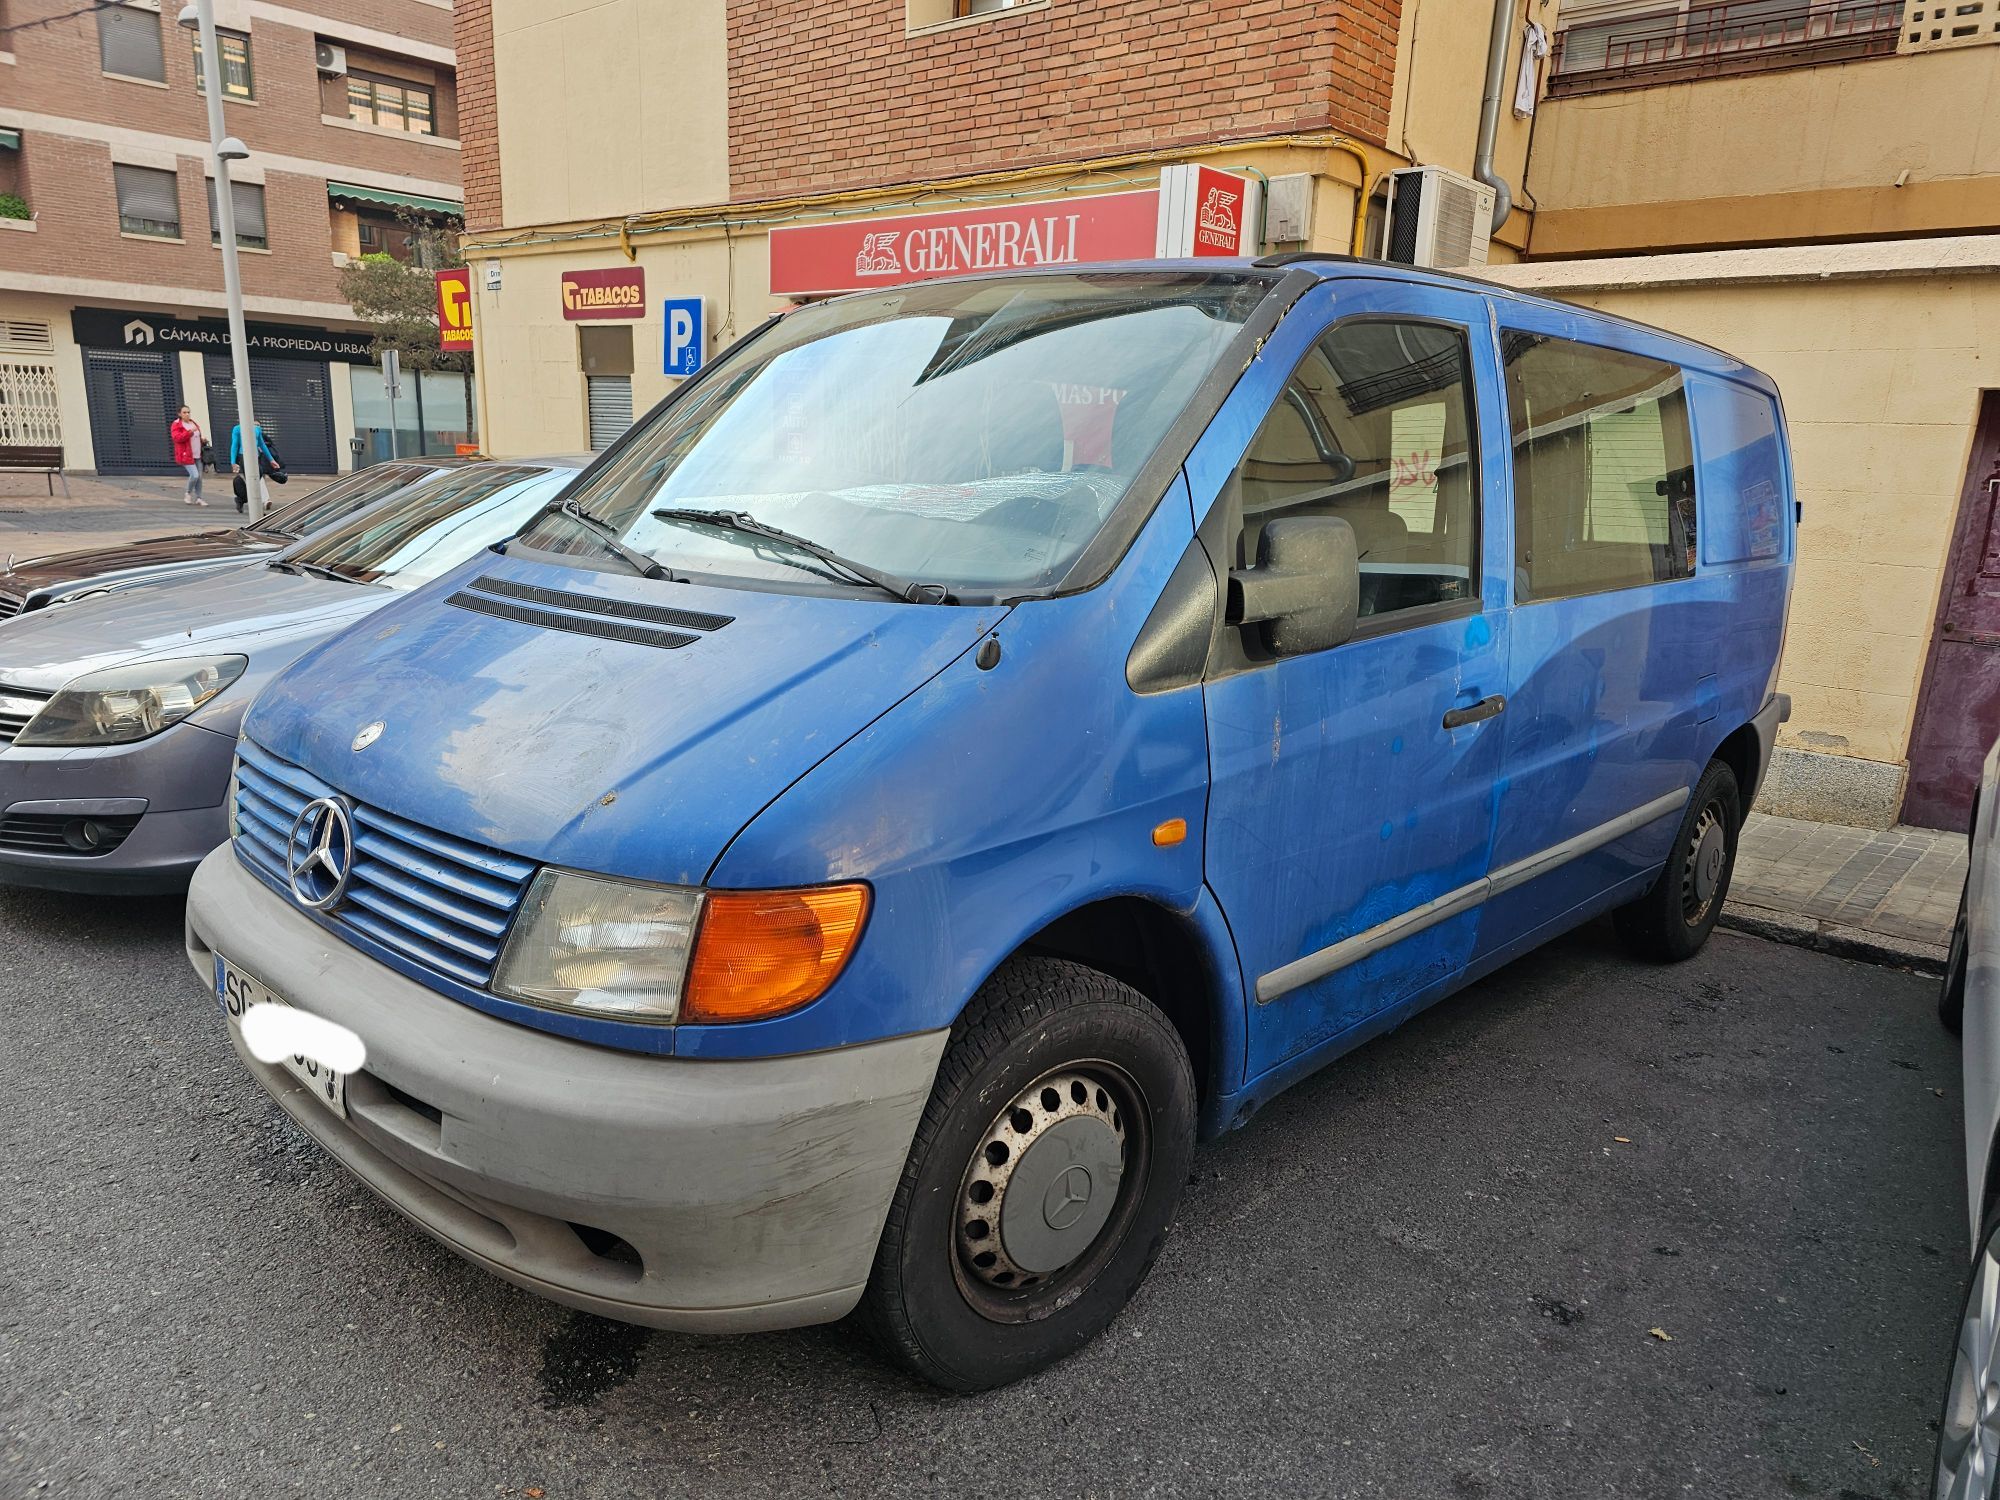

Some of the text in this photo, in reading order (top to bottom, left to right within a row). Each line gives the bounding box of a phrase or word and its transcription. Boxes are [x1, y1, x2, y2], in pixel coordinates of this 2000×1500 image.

[904, 215, 1081, 273] GENERALI
[1199, 230, 1235, 250] GENERALI
[580, 285, 640, 305] TABACOS
[160, 326, 219, 343] CÁMARA
[263, 336, 332, 352] PROPIEDAD
[670, 309, 693, 367] P
